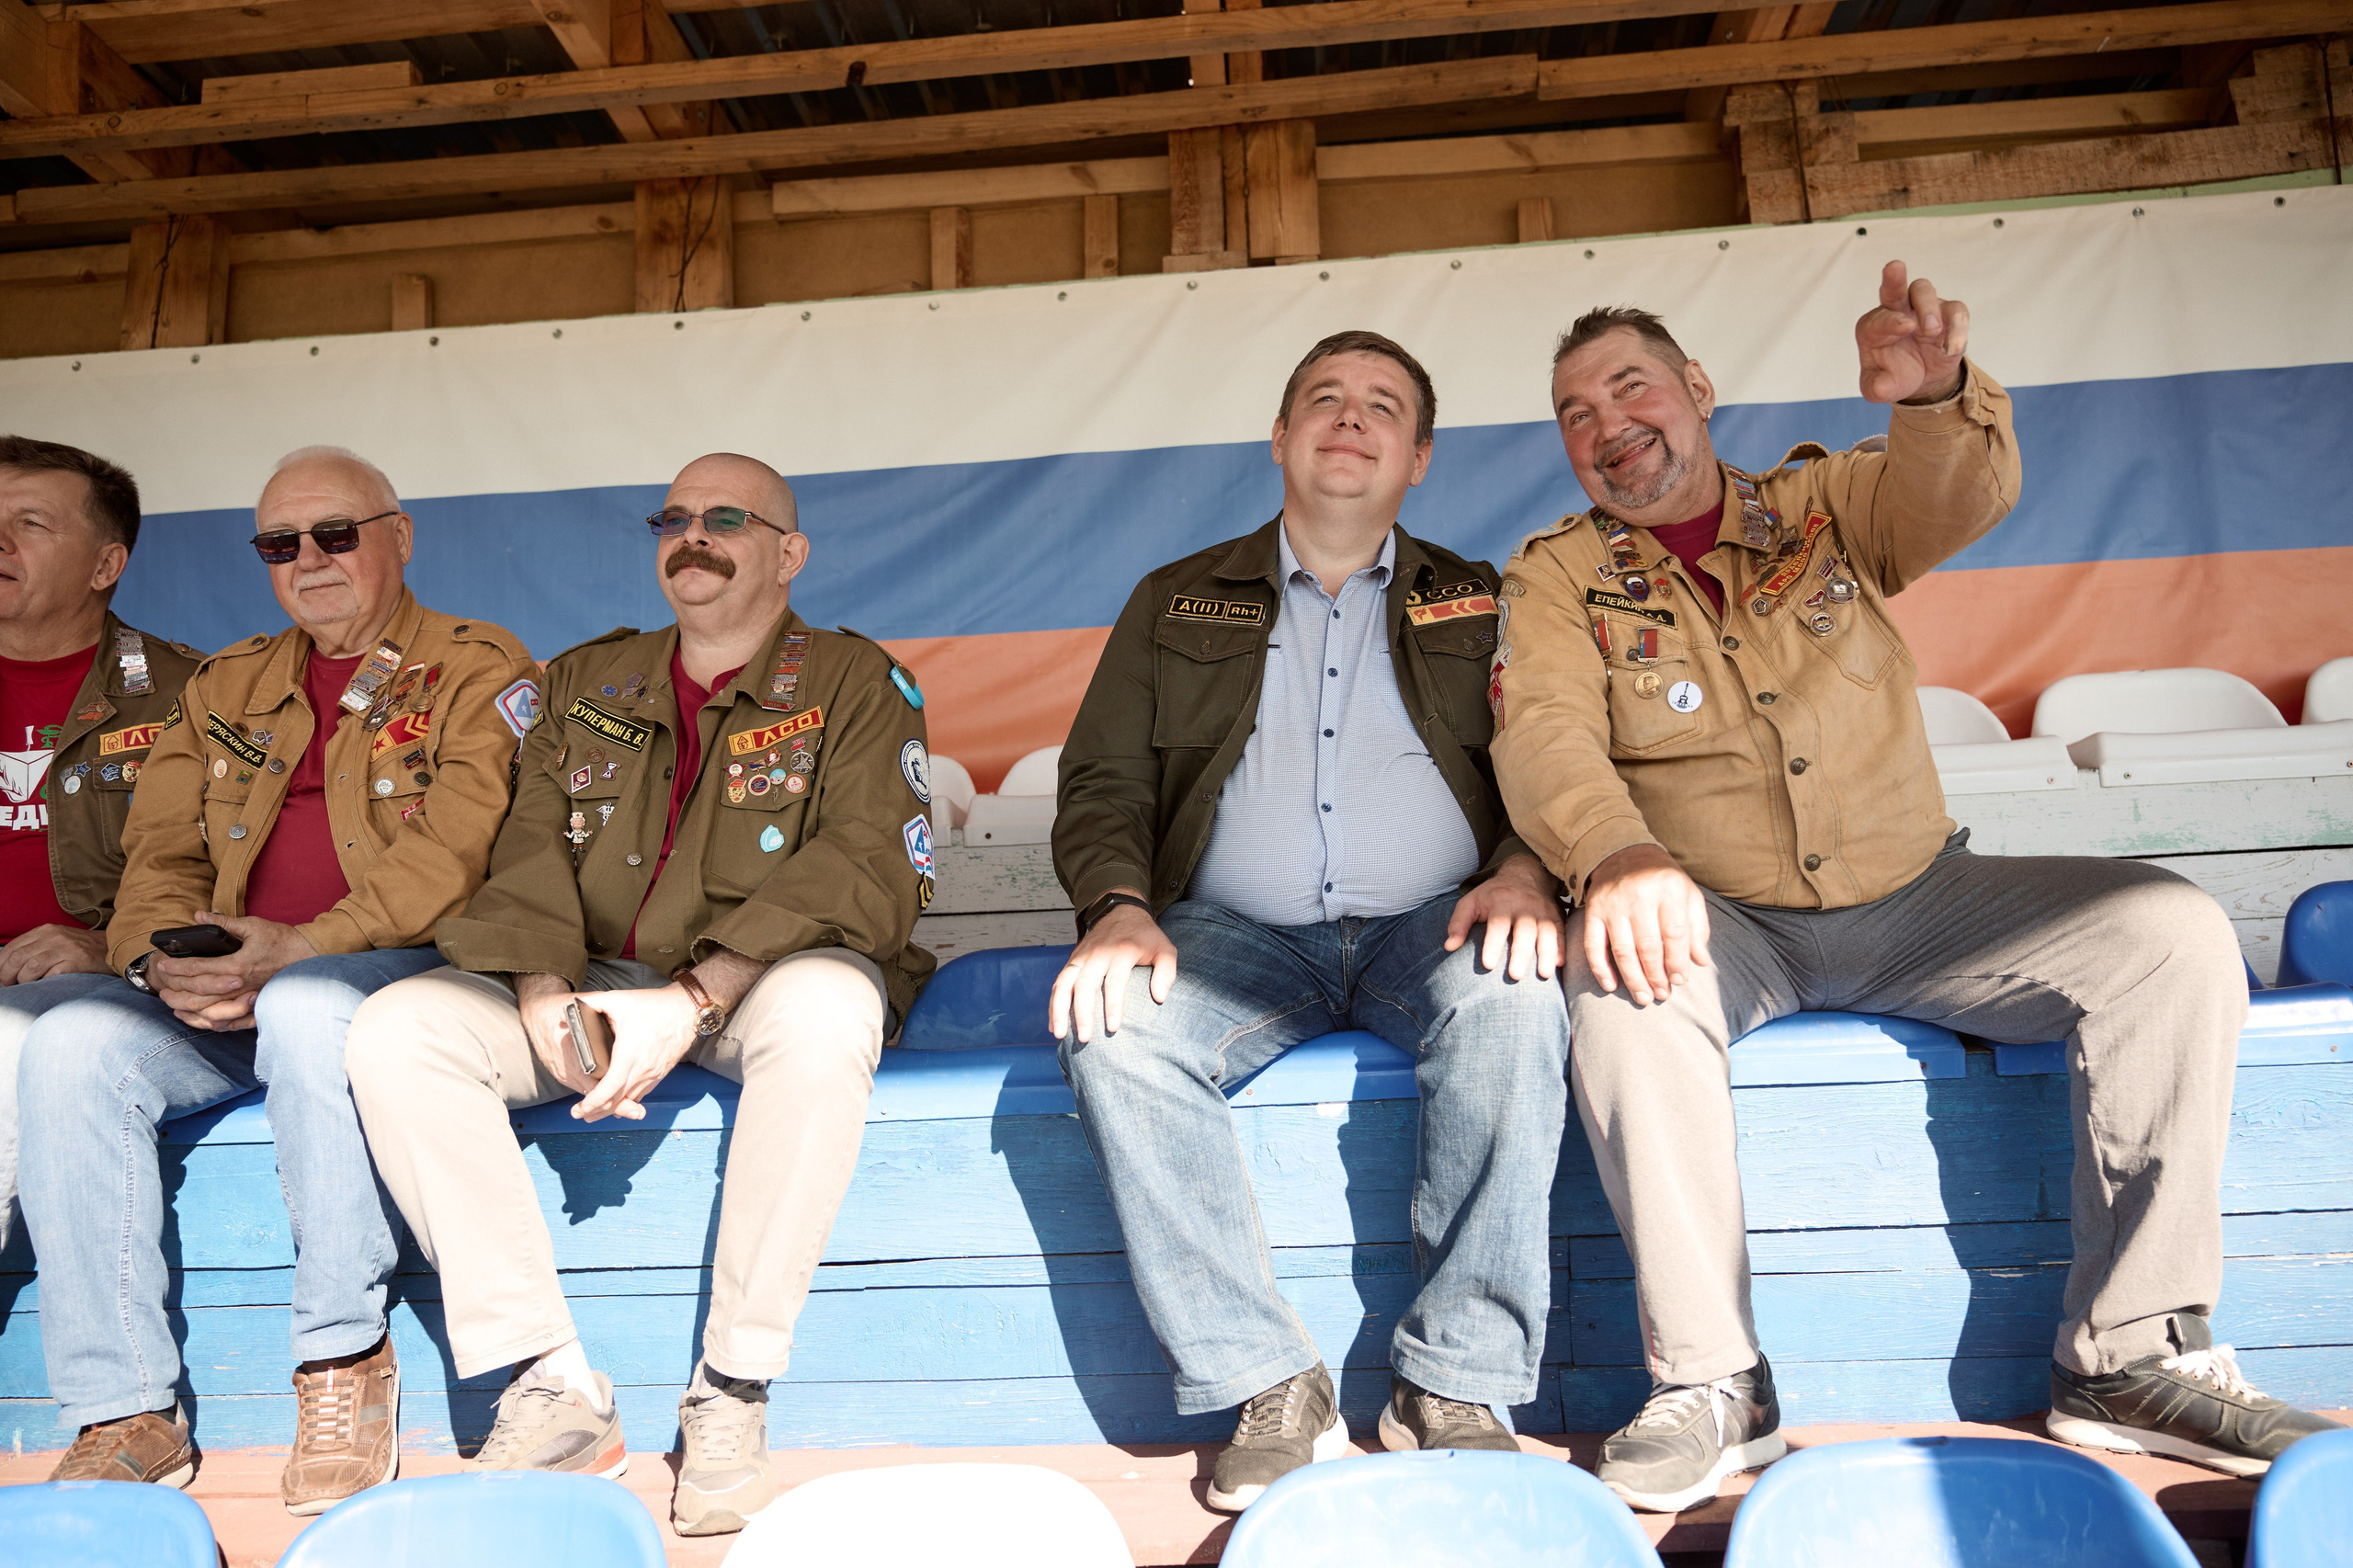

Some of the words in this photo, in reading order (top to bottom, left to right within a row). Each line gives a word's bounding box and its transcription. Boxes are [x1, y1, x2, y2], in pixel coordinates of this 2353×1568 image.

[1231, 607, 1258, 617] Rh+
[1595, 594, 1645, 614] ЕПЕЙКИ
[570, 702, 627, 738] КУПЕРМАН
[622, 728, 633, 742] Б.
[632, 733, 644, 746] В.
